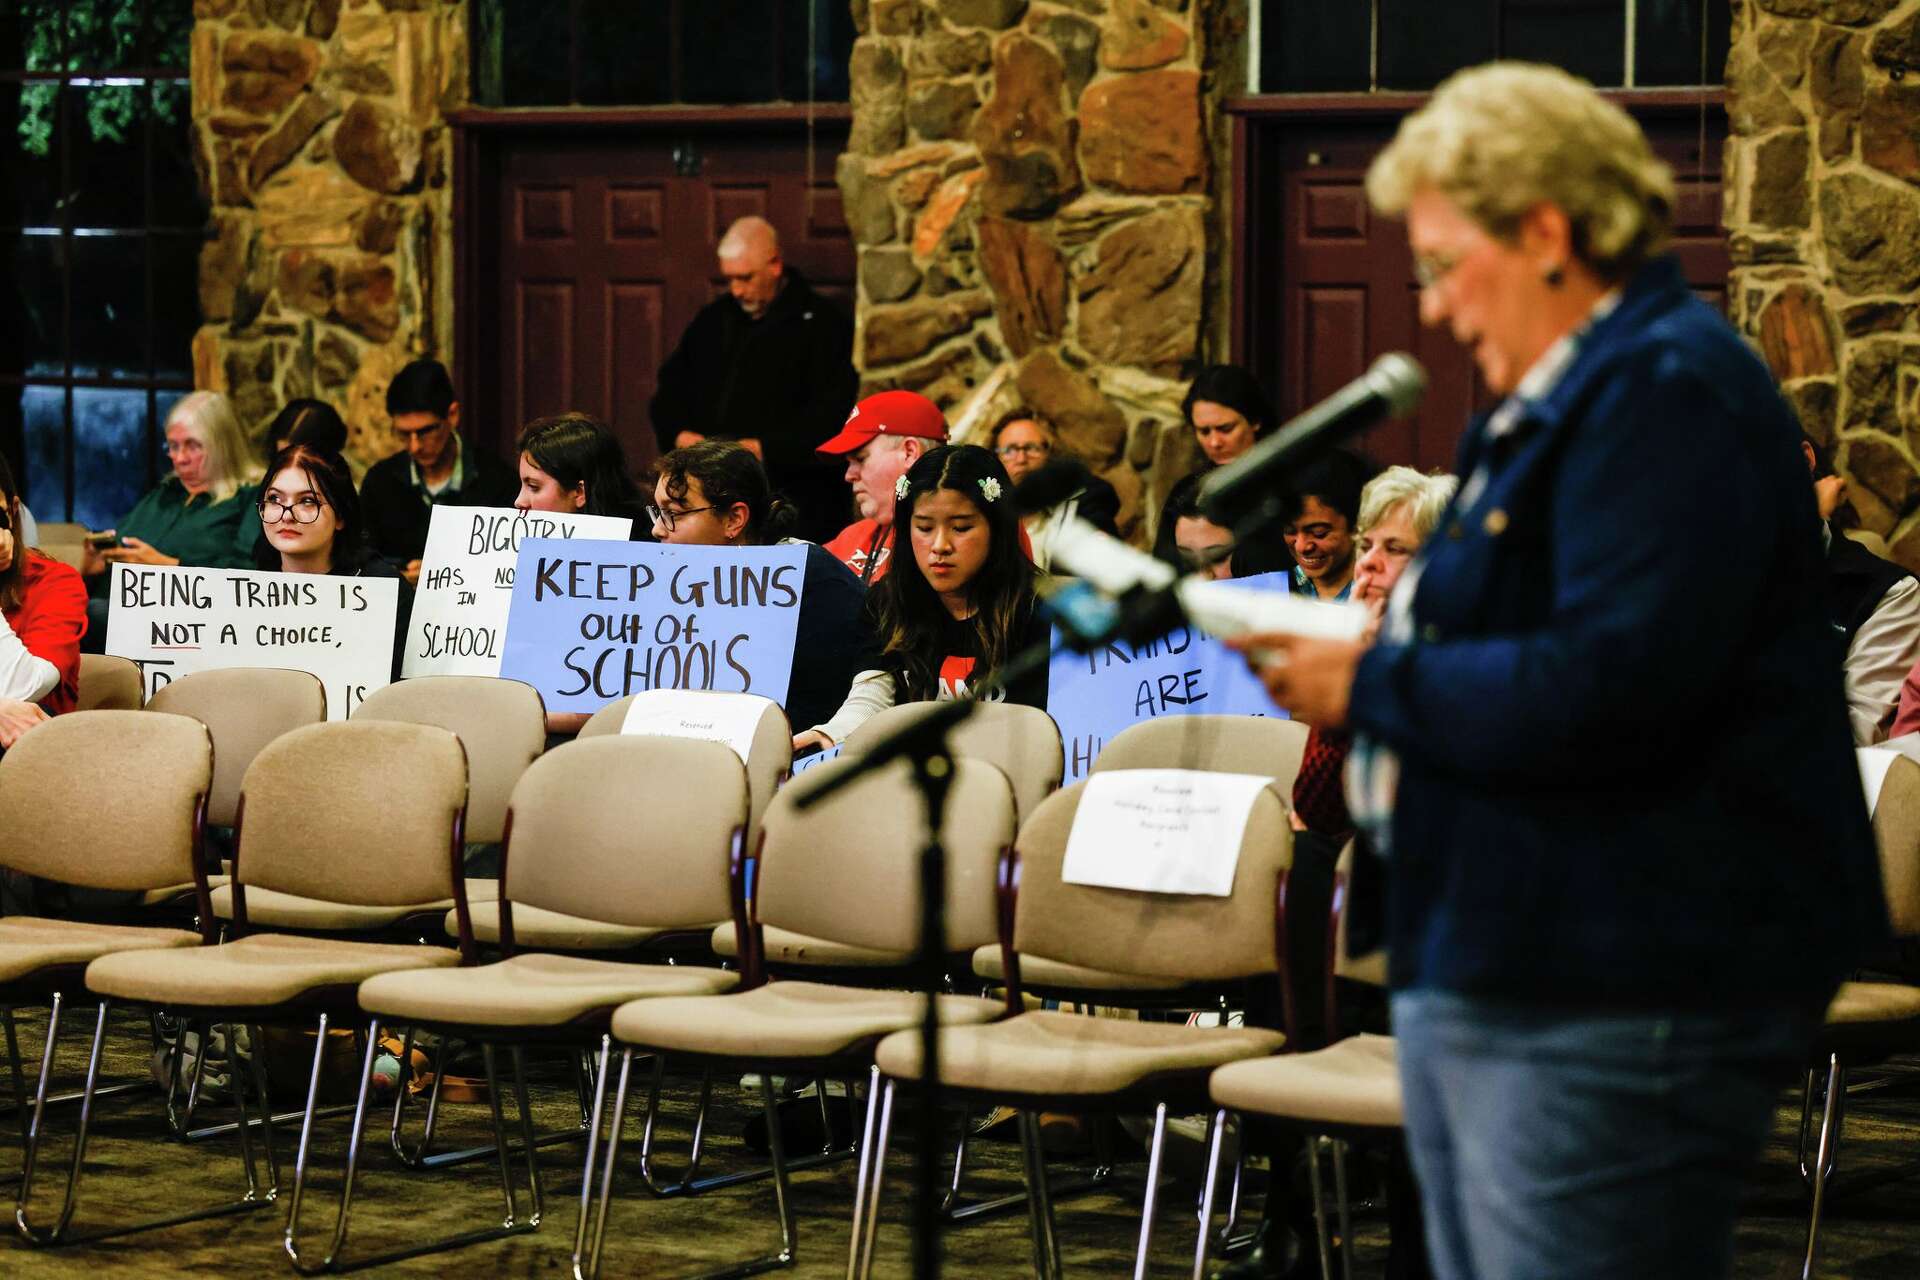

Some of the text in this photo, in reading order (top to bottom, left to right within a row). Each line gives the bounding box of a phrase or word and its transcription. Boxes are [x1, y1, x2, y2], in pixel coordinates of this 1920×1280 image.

[121, 568, 368, 611] BEING TRANS IS
[427, 567, 462, 590] HAS
[457, 591, 477, 606] IN
[535, 557, 798, 608] KEEP GUNS
[151, 620, 342, 649] NOT A CHOICE,
[556, 633, 752, 699] SCHOOLS
[1135, 669, 1209, 717] ARE
